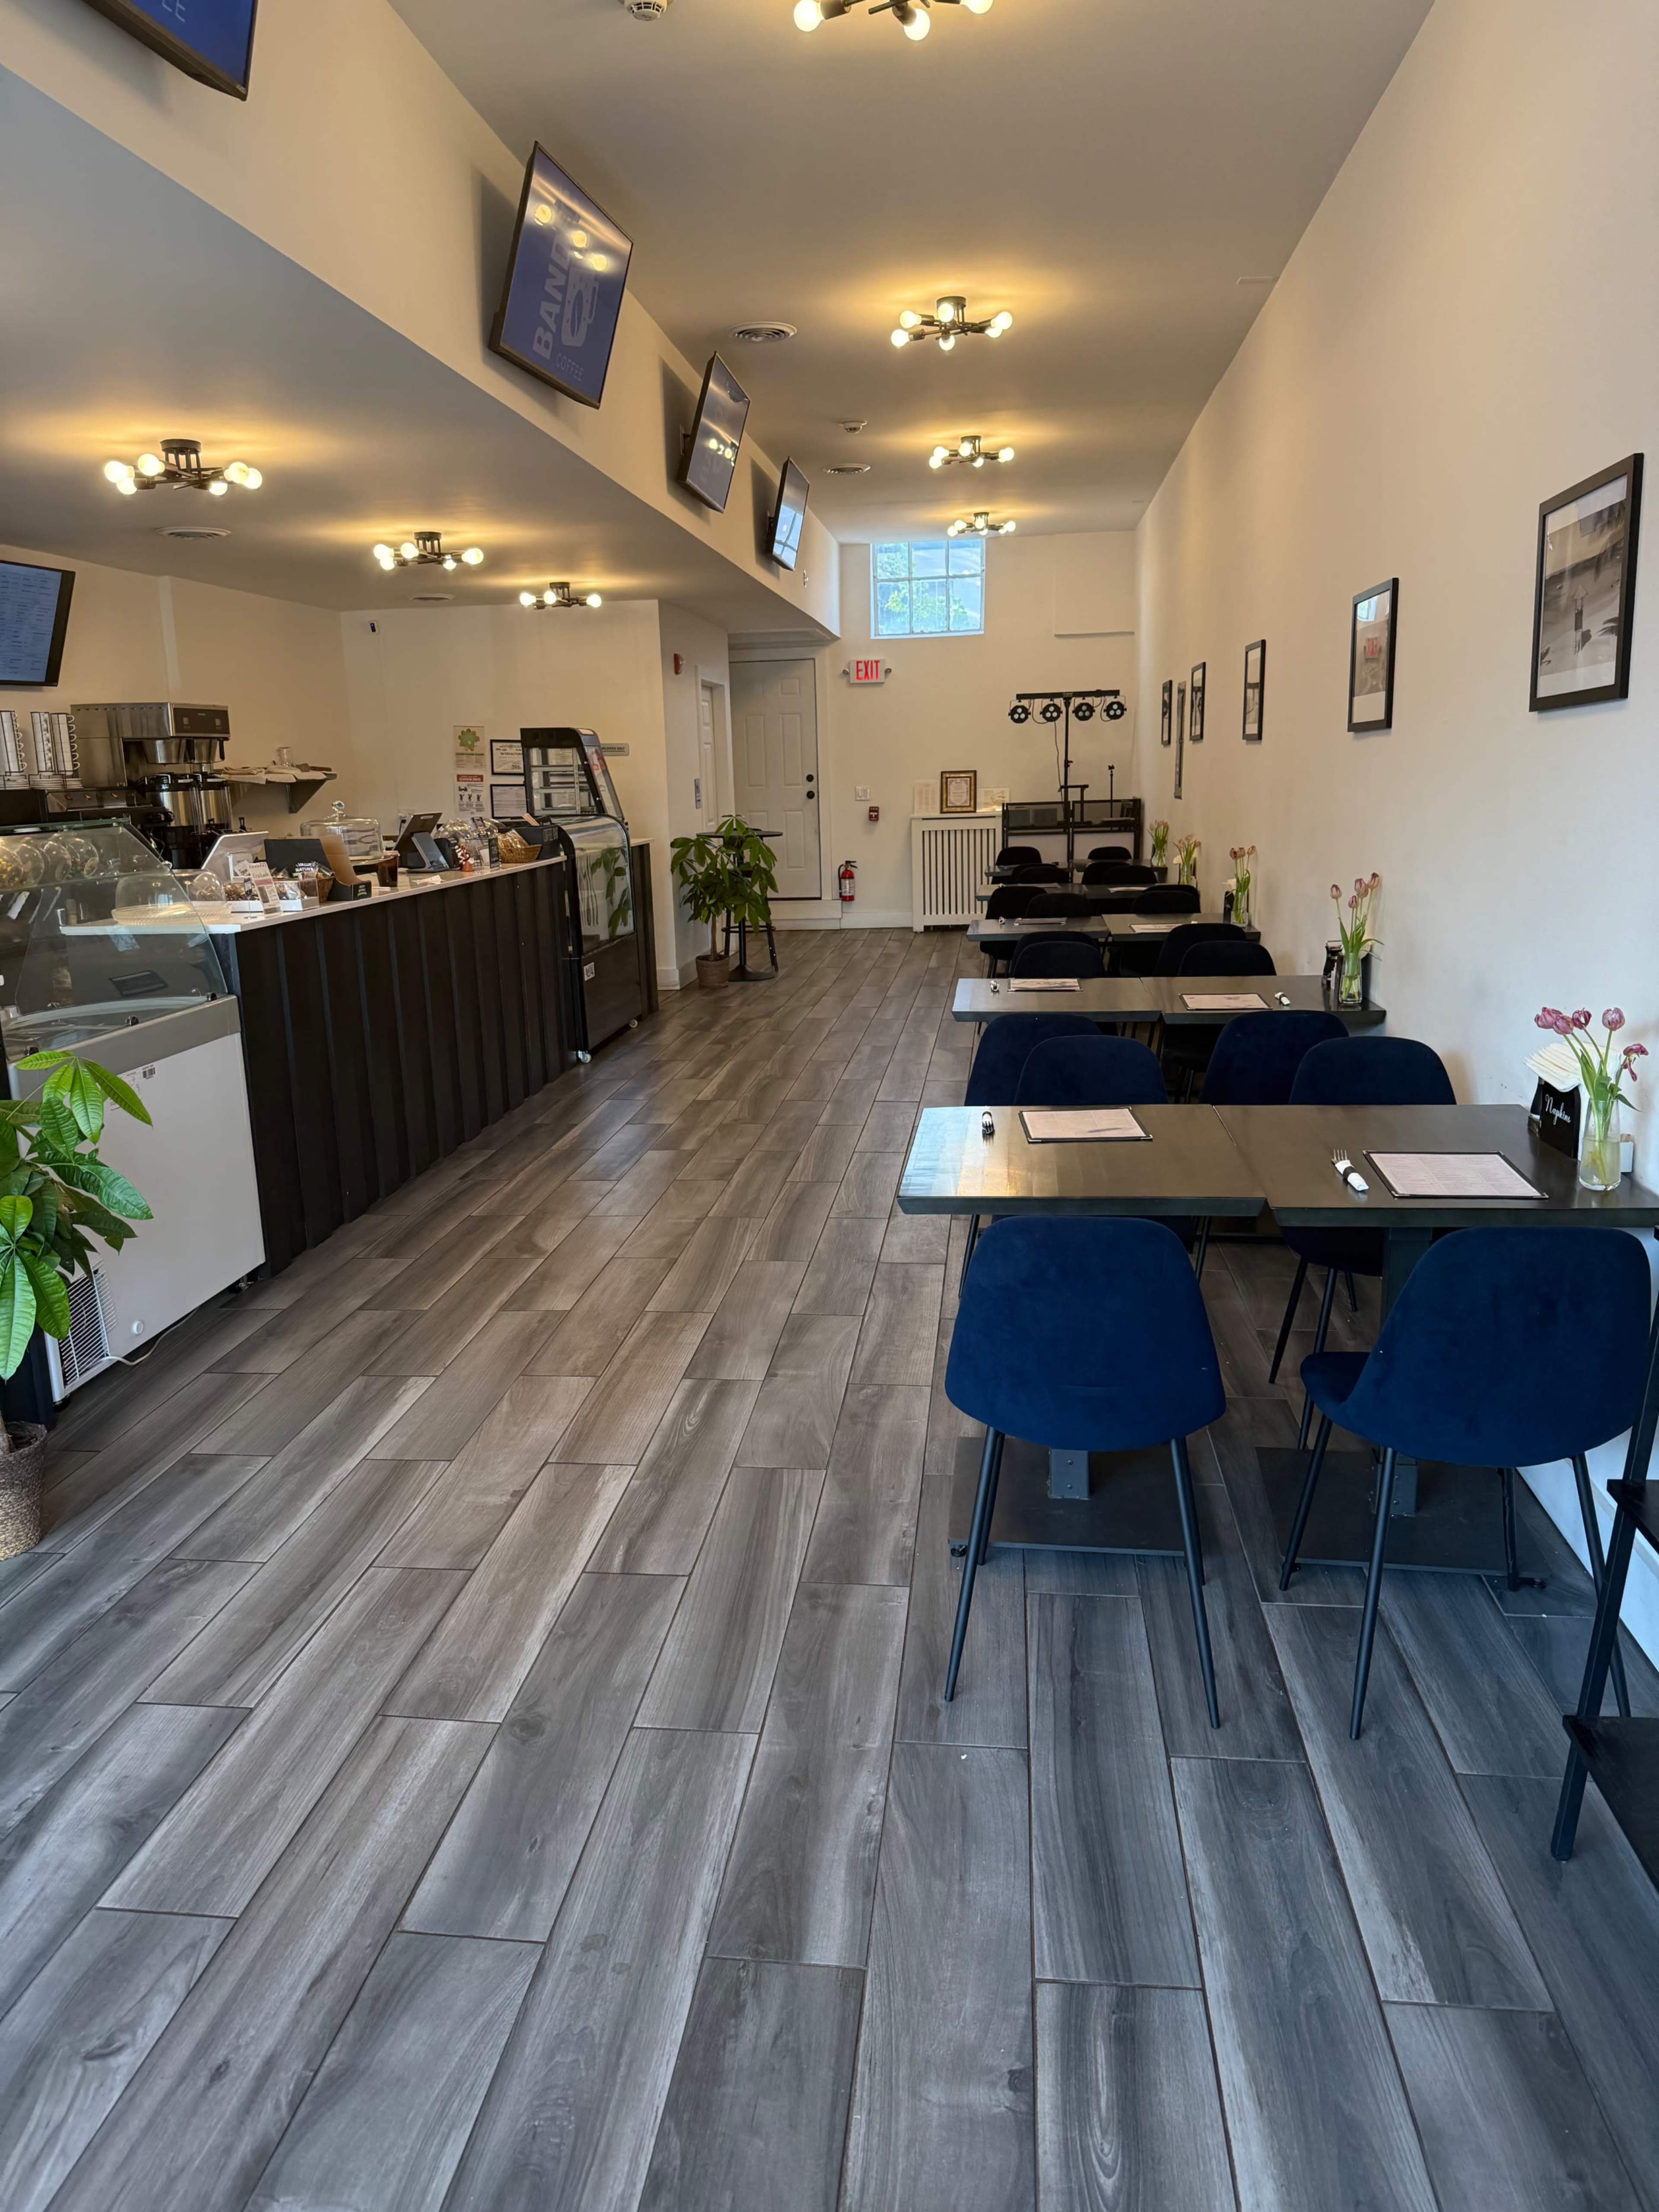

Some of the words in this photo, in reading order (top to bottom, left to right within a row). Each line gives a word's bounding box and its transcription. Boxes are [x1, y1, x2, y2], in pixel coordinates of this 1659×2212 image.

[556, 353, 584, 381] COFFEE
[855, 660, 880, 681] EXIT
[1545, 1094, 1571, 1126] Napkins
